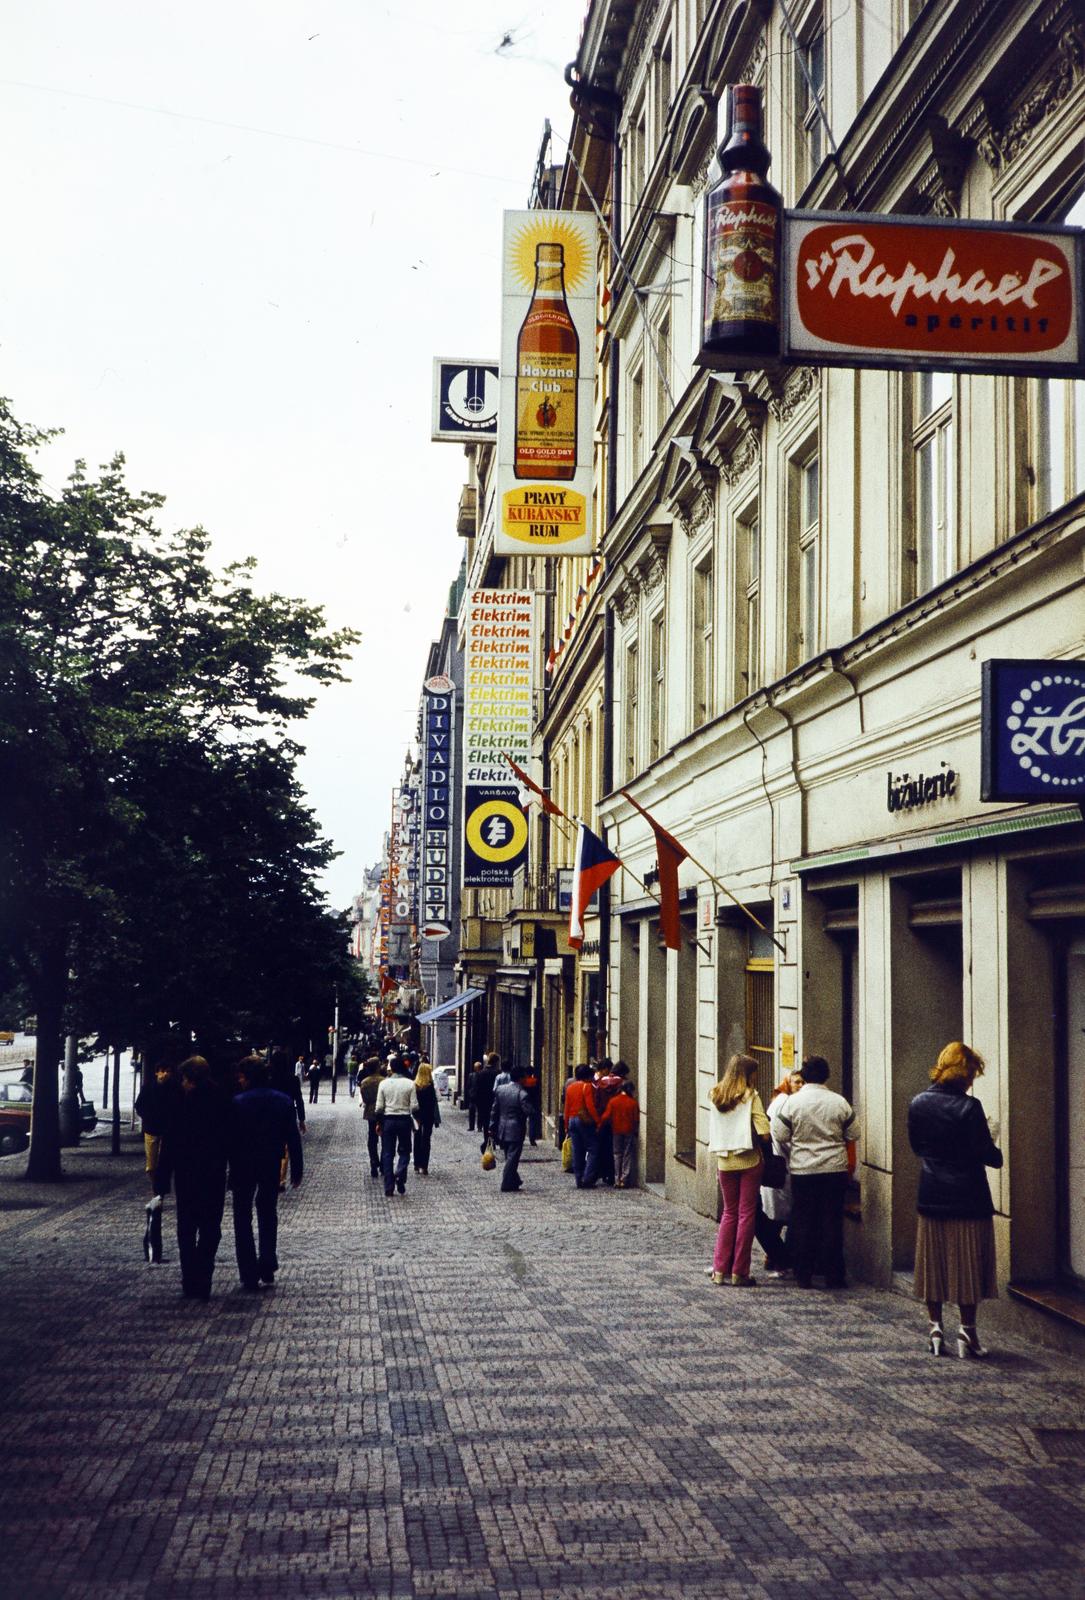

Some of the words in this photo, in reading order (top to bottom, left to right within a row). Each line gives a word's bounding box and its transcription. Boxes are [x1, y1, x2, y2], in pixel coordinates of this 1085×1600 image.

[521, 364, 574, 378] Havana
[531, 380, 561, 393] Club
[524, 490, 567, 505] PRAVÝ
[508, 505, 581, 521] KUBÁNSKÝ
[529, 524, 559, 537] RUM
[471, 591, 531, 605] Elektrim
[471, 608, 531, 622] Elektrim
[471, 624, 530, 638] Elektrim
[470, 640, 530, 654] Elektrim
[470, 656, 530, 669] Elektrim
[470, 672, 529, 685] Elektrim
[469, 688, 529, 701] Elektrim
[469, 704, 529, 717] Elektrim
[469, 719, 528, 733] Elektrim
[468, 735, 528, 748] Elektrim
[429, 697, 448, 820] DIVADLO
[427, 831, 446, 920] HUDBY
[481, 869, 509, 877] polská
